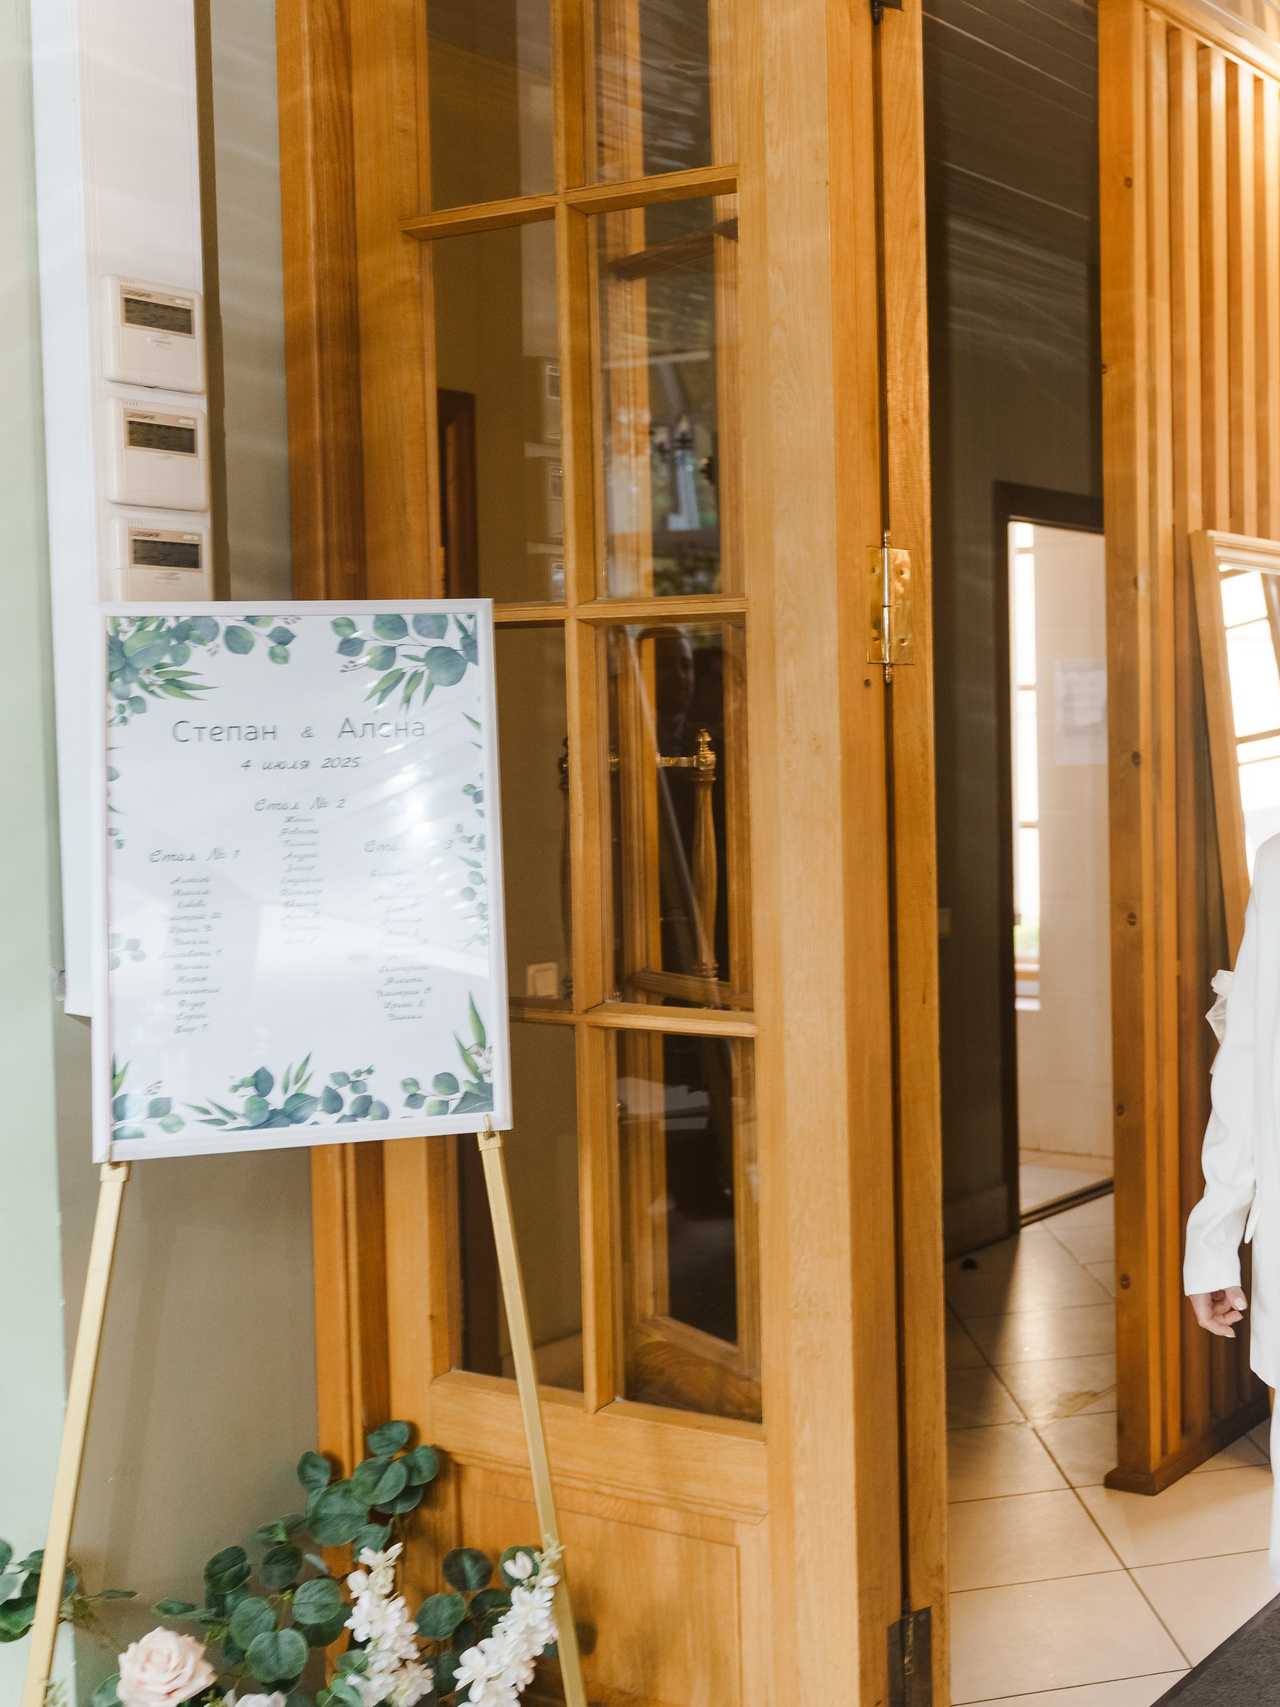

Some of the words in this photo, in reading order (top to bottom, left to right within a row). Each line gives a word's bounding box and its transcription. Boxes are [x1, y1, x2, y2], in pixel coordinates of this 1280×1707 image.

[172, 719, 279, 743] Степан
[300, 725, 315, 739] &
[240, 759, 252, 771] 4
[262, 759, 310, 771] июля
[320, 756, 362, 770] 2025
[254, 798, 300, 812] Стол
[309, 796, 328, 811] №
[336, 798, 347, 809] 2
[149, 849, 197, 863] Стол
[206, 847, 227, 861] №
[233, 849, 242, 859] 1
